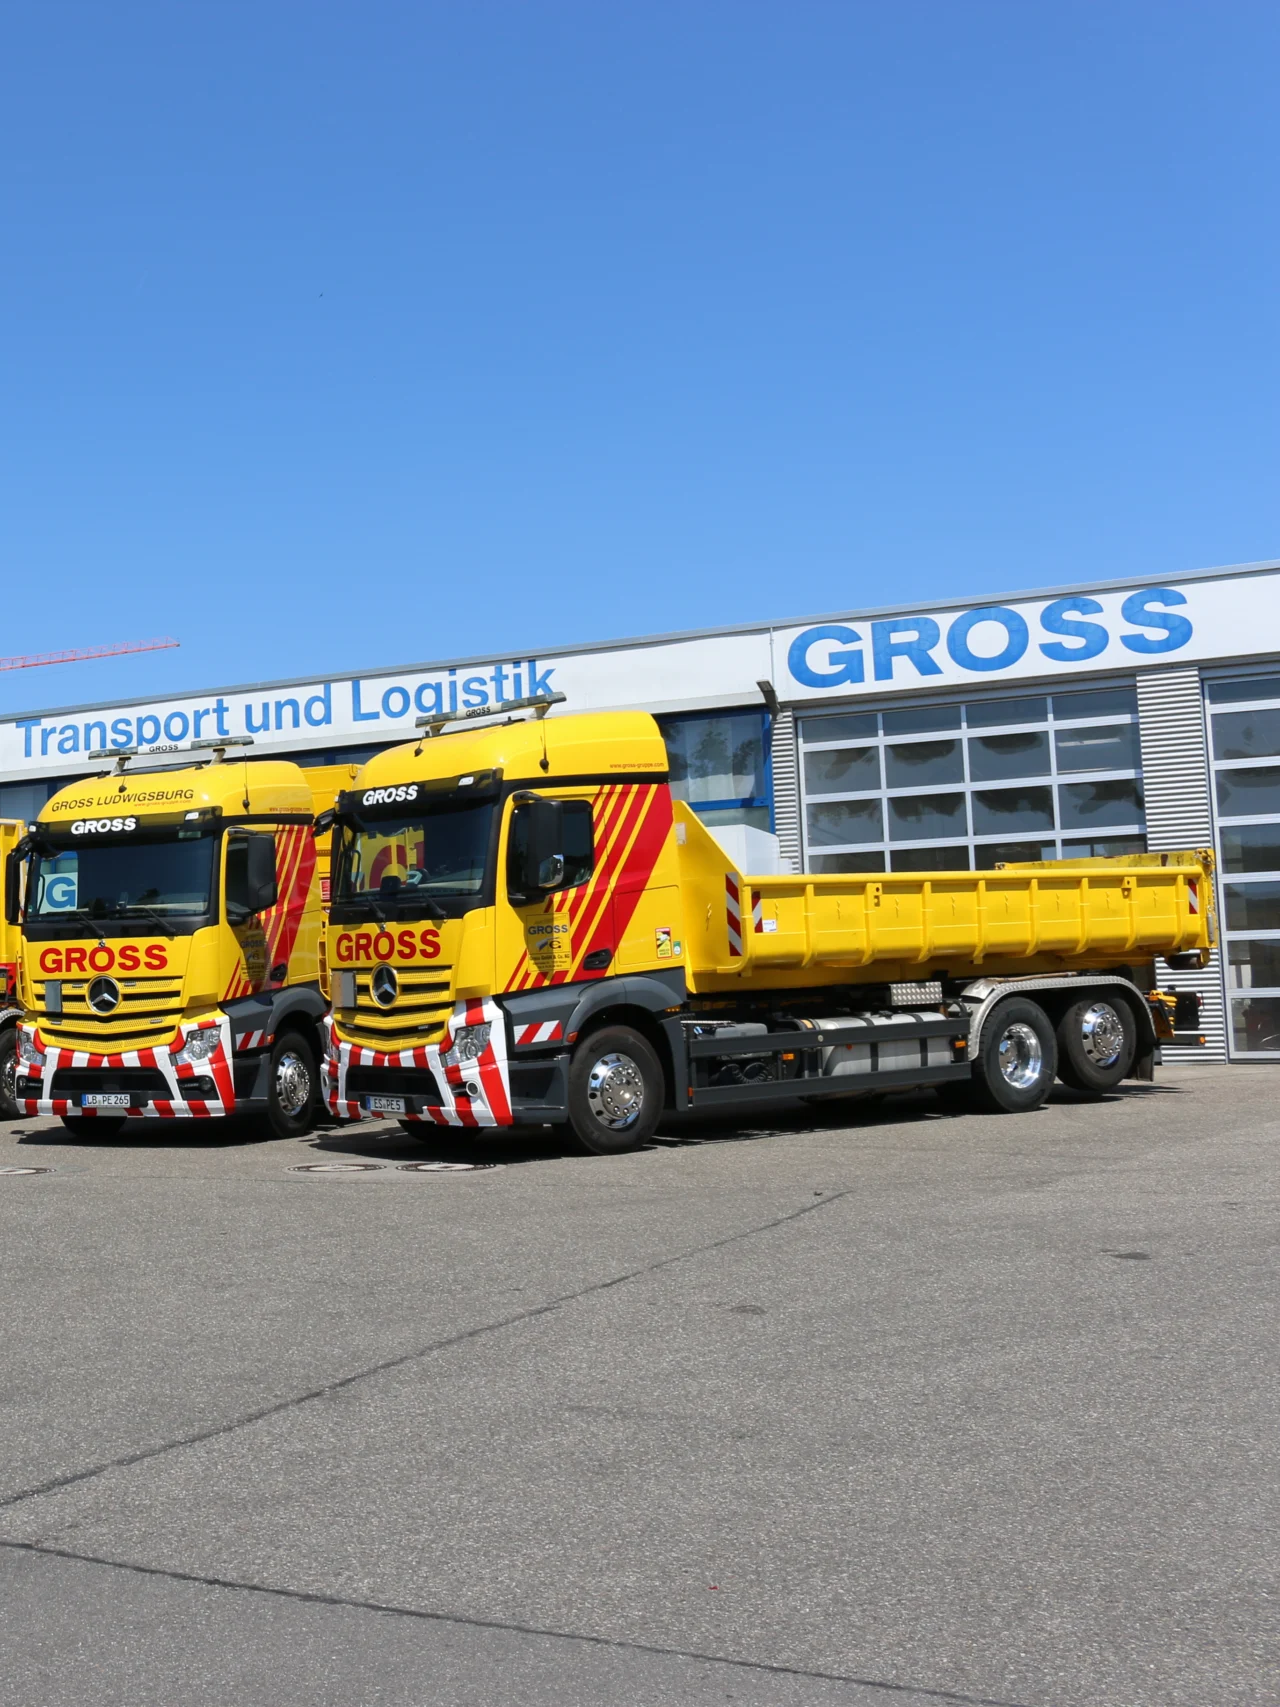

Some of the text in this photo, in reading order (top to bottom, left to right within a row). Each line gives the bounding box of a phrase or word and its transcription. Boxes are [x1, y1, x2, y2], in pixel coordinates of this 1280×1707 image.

[788, 588, 1193, 688] GROSS
[16, 659, 556, 758] Transport und Logistik
[465, 706, 491, 717] GROSS
[148, 743, 179, 752] GROSS
[52, 789, 195, 812] GROSS LUDWIGSBURG
[362, 785, 419, 806] GROSS
[70, 817, 137, 835] GROSS
[528, 924, 568, 935] GROSS
[336, 929, 441, 962] GROSS
[40, 944, 168, 973] GROSS
[87, 1095, 129, 1104] LB PE 265
[374, 1099, 401, 1110] ES PE 5
